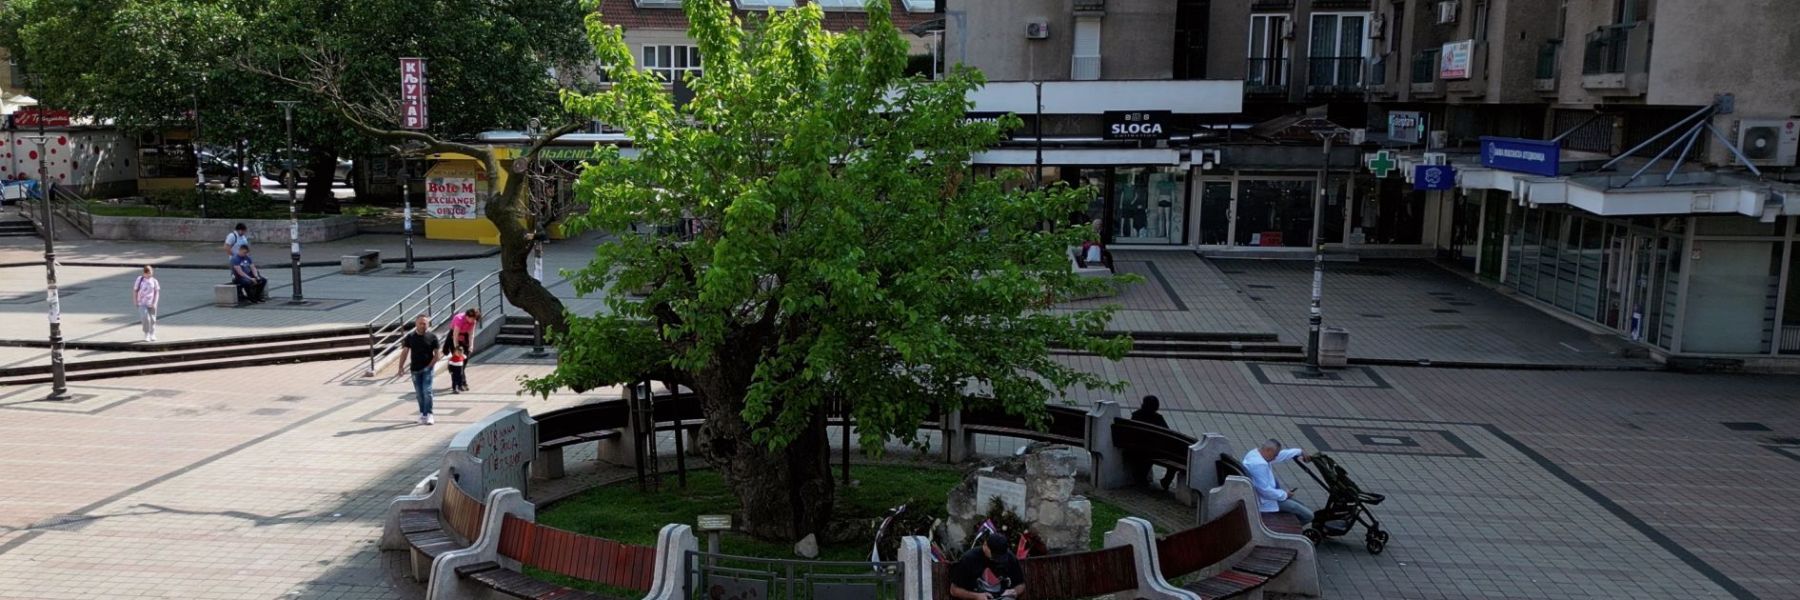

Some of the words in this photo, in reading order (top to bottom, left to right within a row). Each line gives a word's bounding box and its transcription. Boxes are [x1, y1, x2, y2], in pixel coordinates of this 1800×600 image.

[404, 62, 418, 127] КЉУЧАР
[1111, 123, 1163, 134] SLOGA
[462, 183, 474, 193] M
